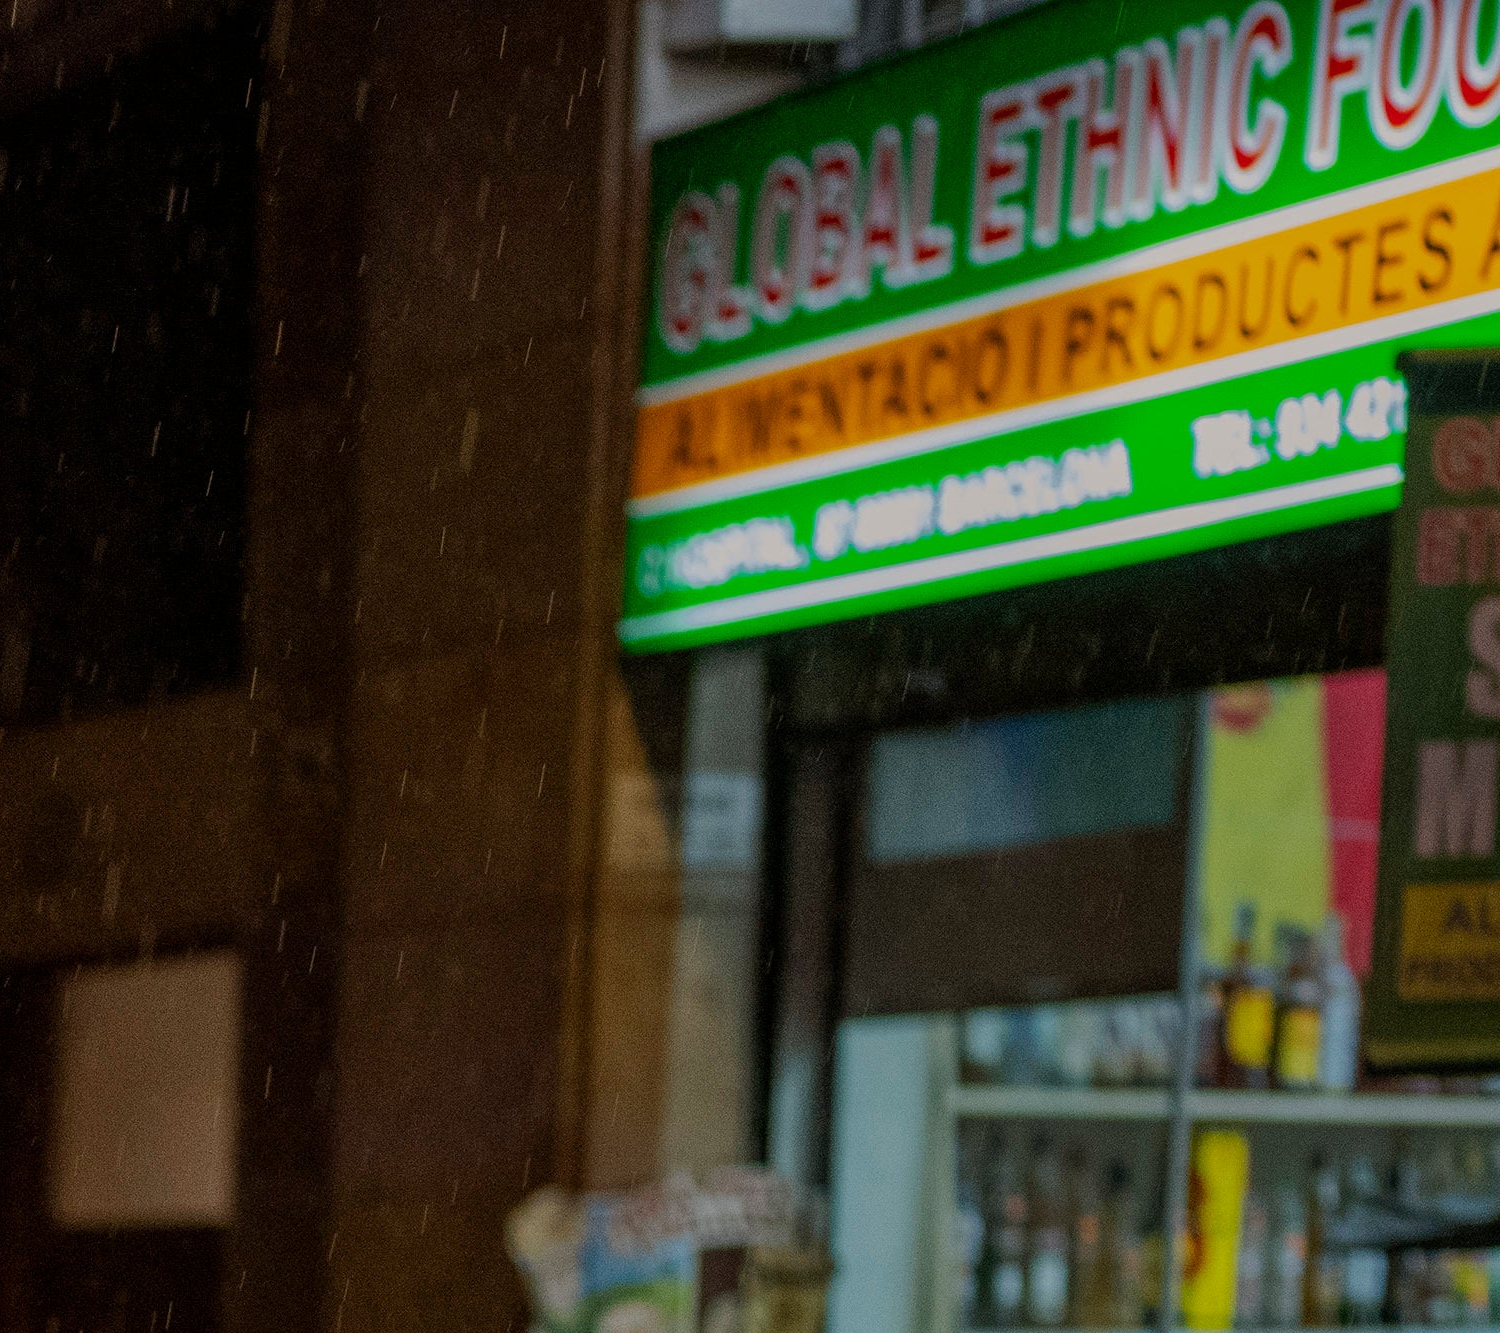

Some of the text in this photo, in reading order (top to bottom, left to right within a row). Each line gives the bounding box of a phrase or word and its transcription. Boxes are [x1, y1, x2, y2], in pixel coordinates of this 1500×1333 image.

[656, 112, 955, 354] GLOBAL
[968, 0, 1293, 266] ETHNIC
[1060, 207, 1455, 388] PRODUCTES
